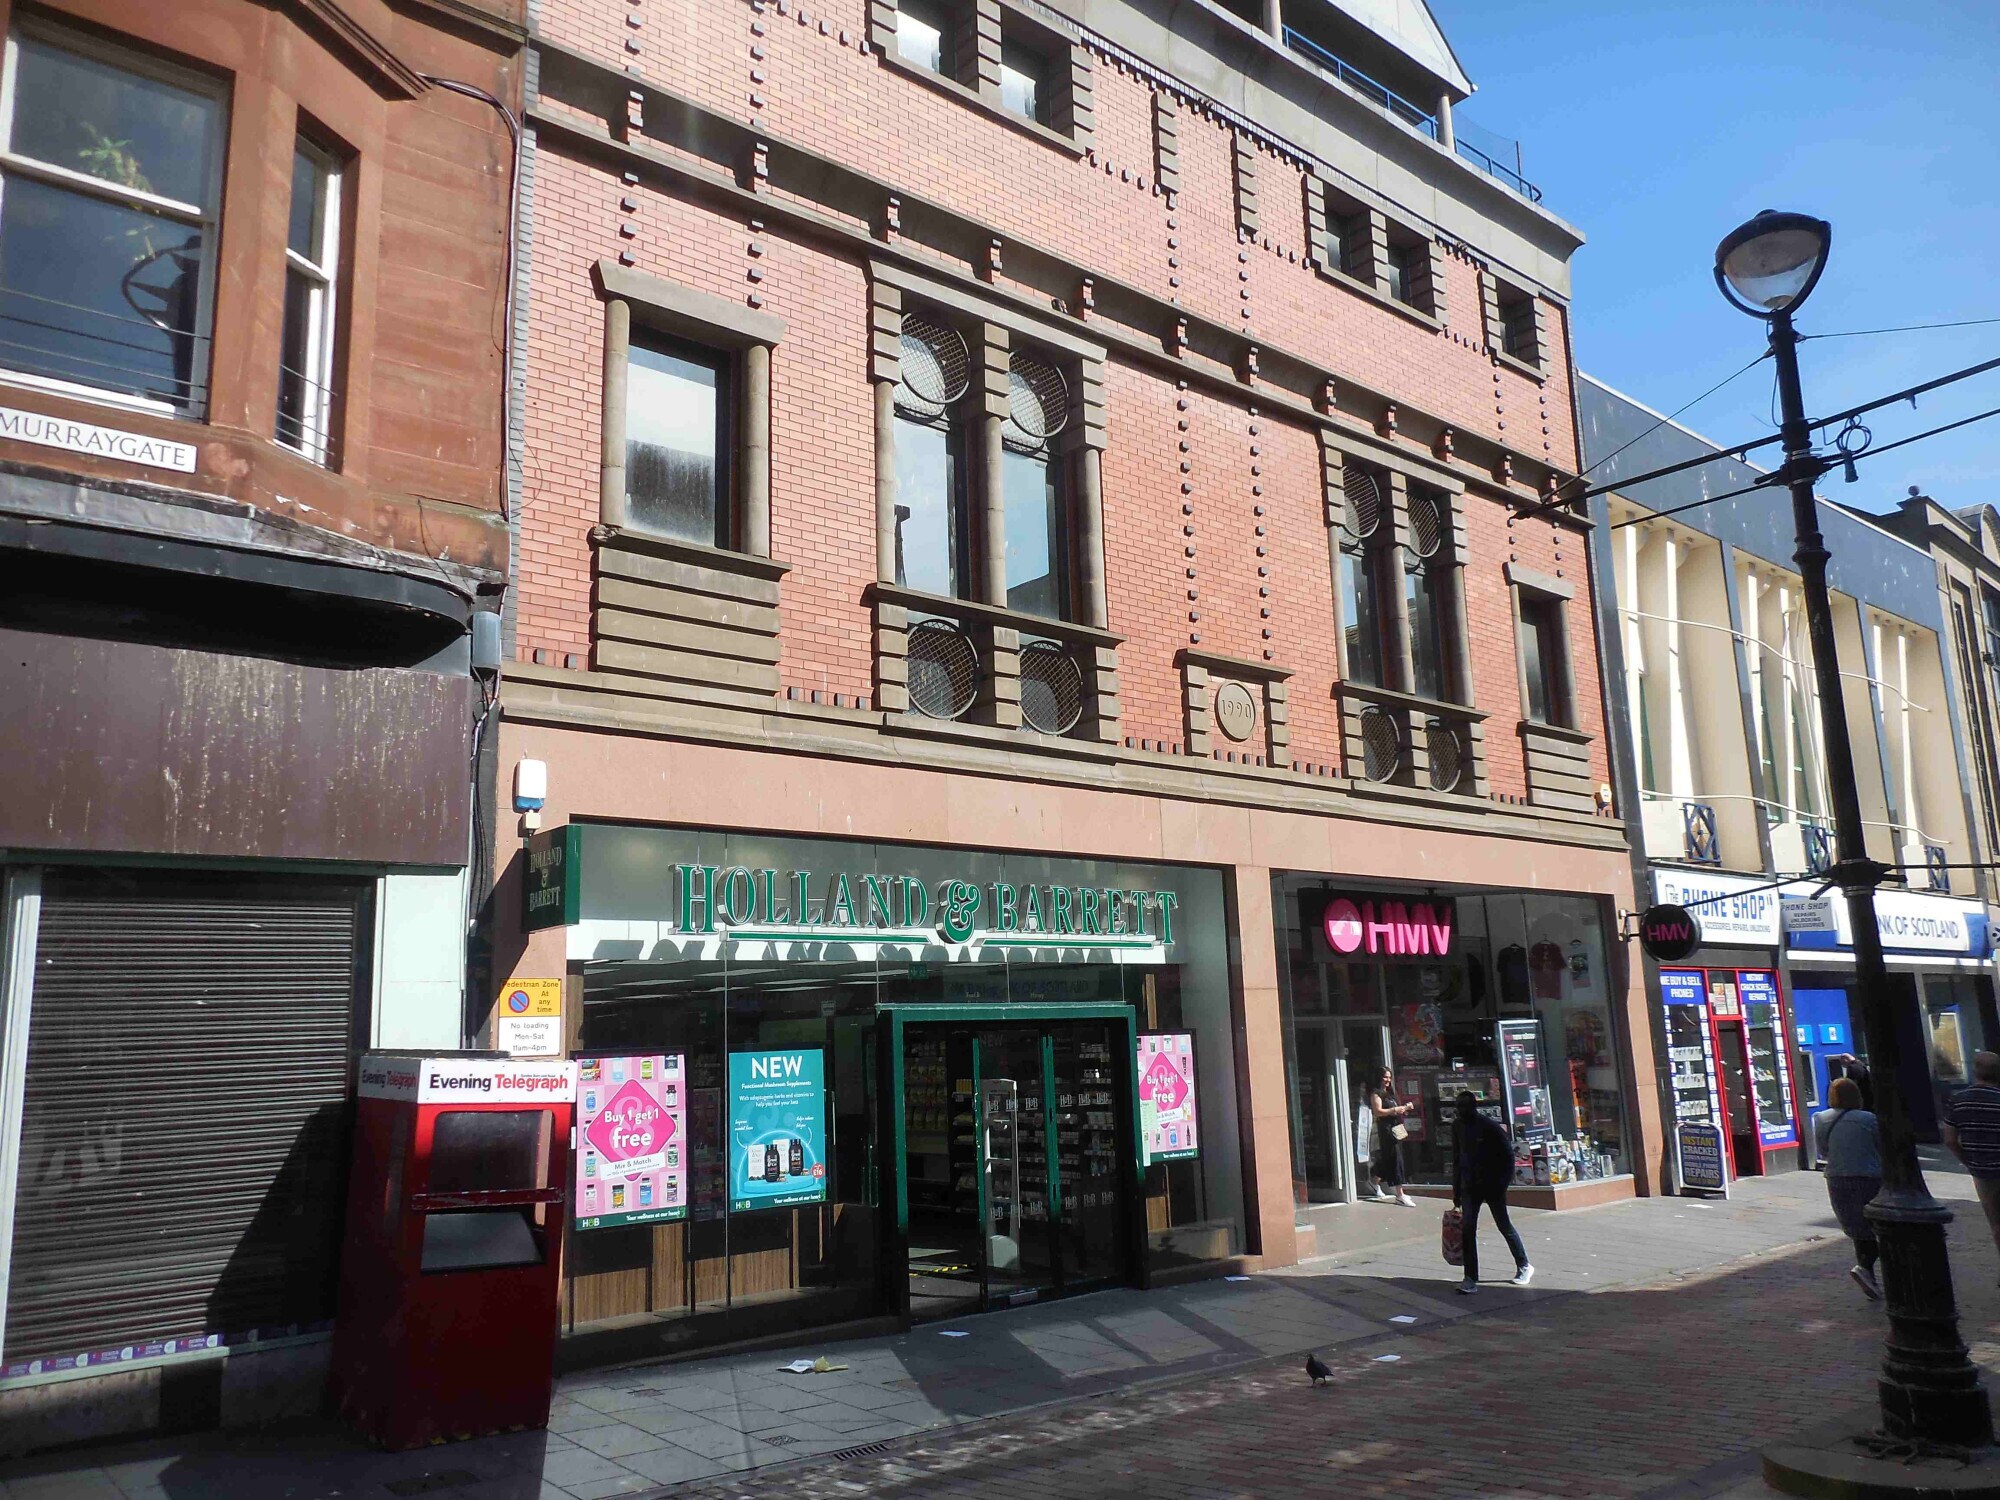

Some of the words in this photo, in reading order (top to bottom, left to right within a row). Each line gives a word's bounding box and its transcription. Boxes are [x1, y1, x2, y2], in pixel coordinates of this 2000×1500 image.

[0, 413, 187, 466] MURRAYGATE
[1222, 699, 1252, 719] 1990
[530, 846, 562, 873] HOLLAND
[529, 886, 561, 912] BARRETT
[669, 863, 929, 935] HOLLAND
[935, 879, 981, 944] &
[985, 881, 1179, 945] BARRETT
[1682, 888, 1728, 917] PHONE
[1733, 893, 1765, 920] SHOP
[1807, 902, 1829, 910] SHOP
[1361, 899, 1451, 957] HMV
[1647, 922, 1691, 942] HMV
[1877, 915, 1894, 935] NK
[1895, 916, 1909, 936] OF
[1911, 917, 1959, 939] SCOTLAND
[751, 1055, 803, 1079] NEW
[362, 1069, 386, 1085] Evening
[386, 1070, 416, 1090] Telegraph
[430, 1073, 492, 1092] Evening
[494, 1074, 568, 1092] Telegraph
[1146, 1075, 1158, 1087] Buy
[1164, 1076, 1174, 1087] get
[1152, 1090, 1175, 1104] free
[604, 1110, 626, 1124] Buy
[628, 1109, 632, 1120] 1
[635, 1110, 652, 1124] get
[654, 1108, 659, 1119] 1
[612, 1127, 652, 1149] free
[1682, 1136, 1716, 1146] INSTANT
[1683, 1146, 1719, 1156] CRACKED
[1684, 1168, 1720, 1179] REPAIRS
